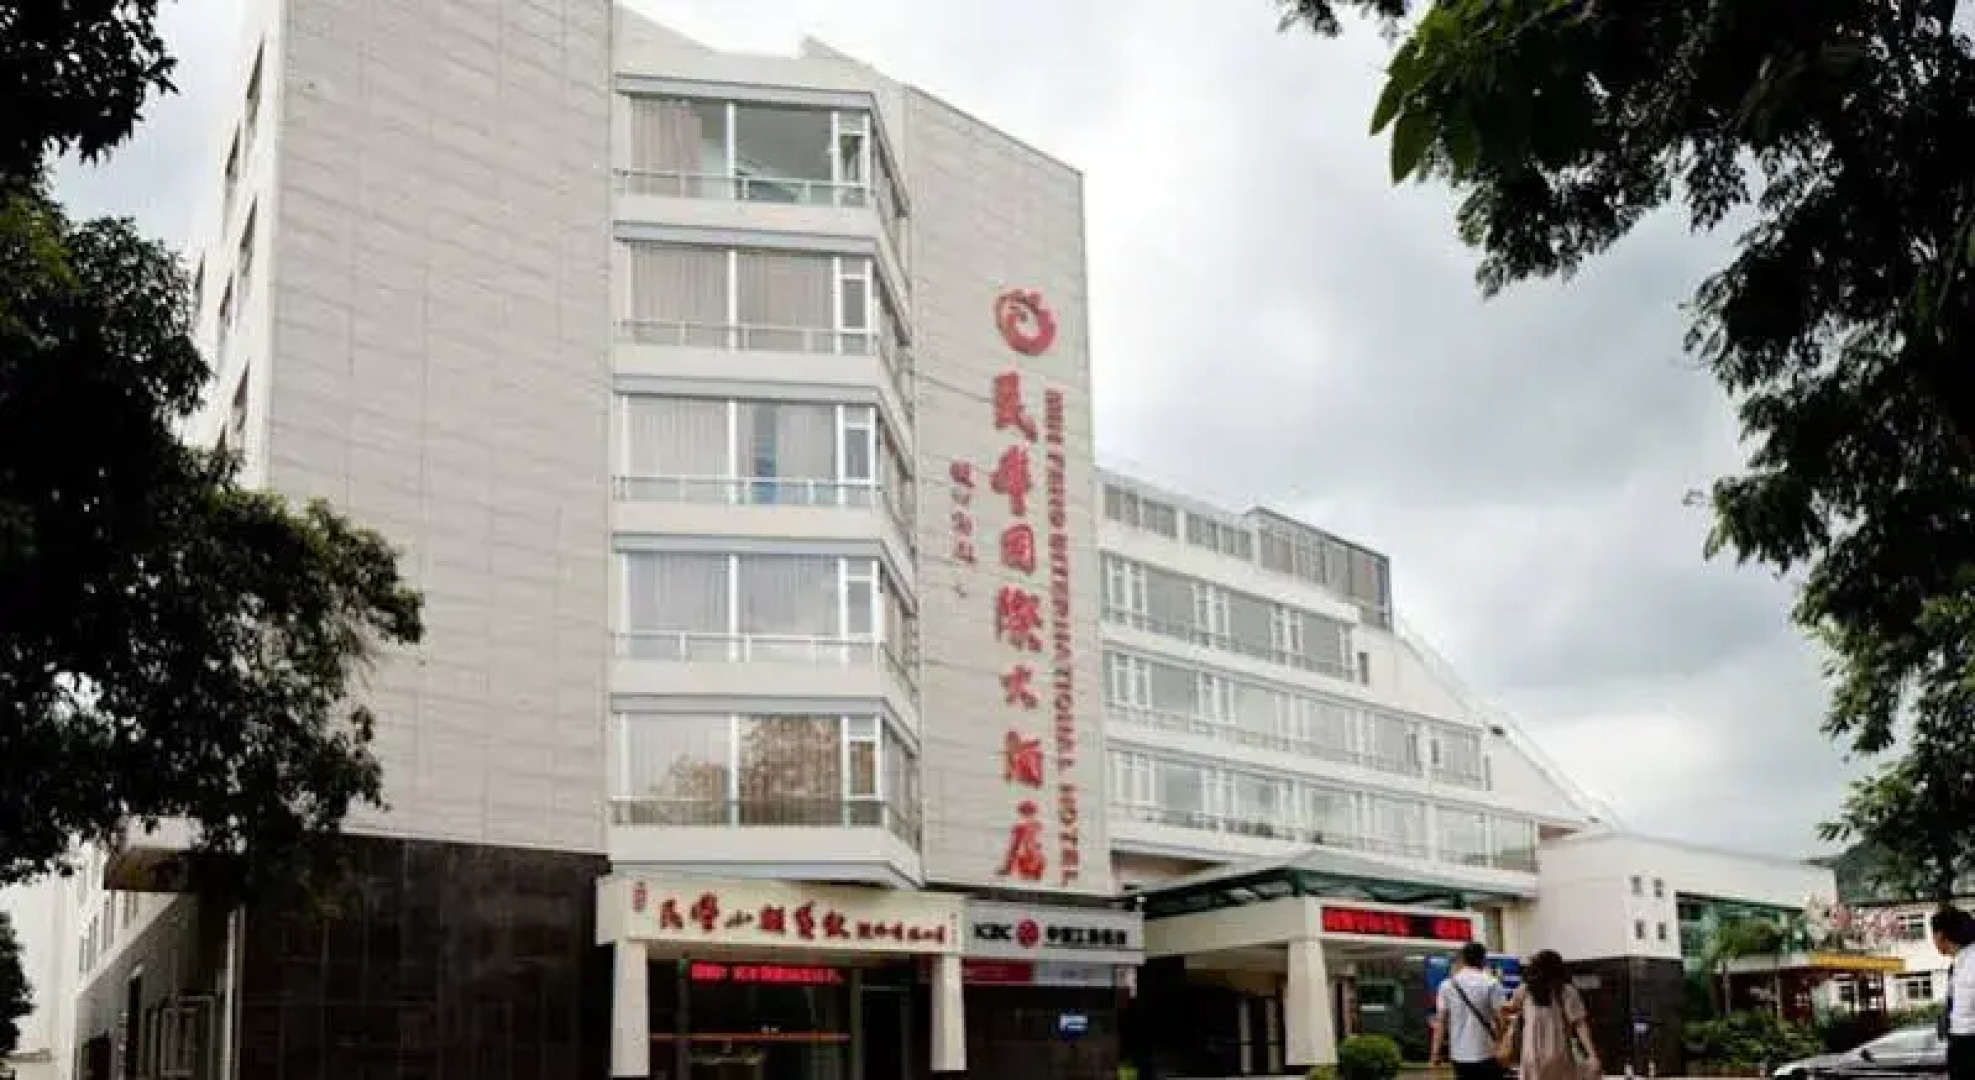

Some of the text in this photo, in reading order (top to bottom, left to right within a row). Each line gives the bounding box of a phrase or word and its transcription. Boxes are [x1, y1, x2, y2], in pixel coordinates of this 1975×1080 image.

[1049, 533, 1075, 772] INTERNATIONAL
[1058, 784, 1080, 886] HOTEL
[974, 922, 1012, 940] ICBC
